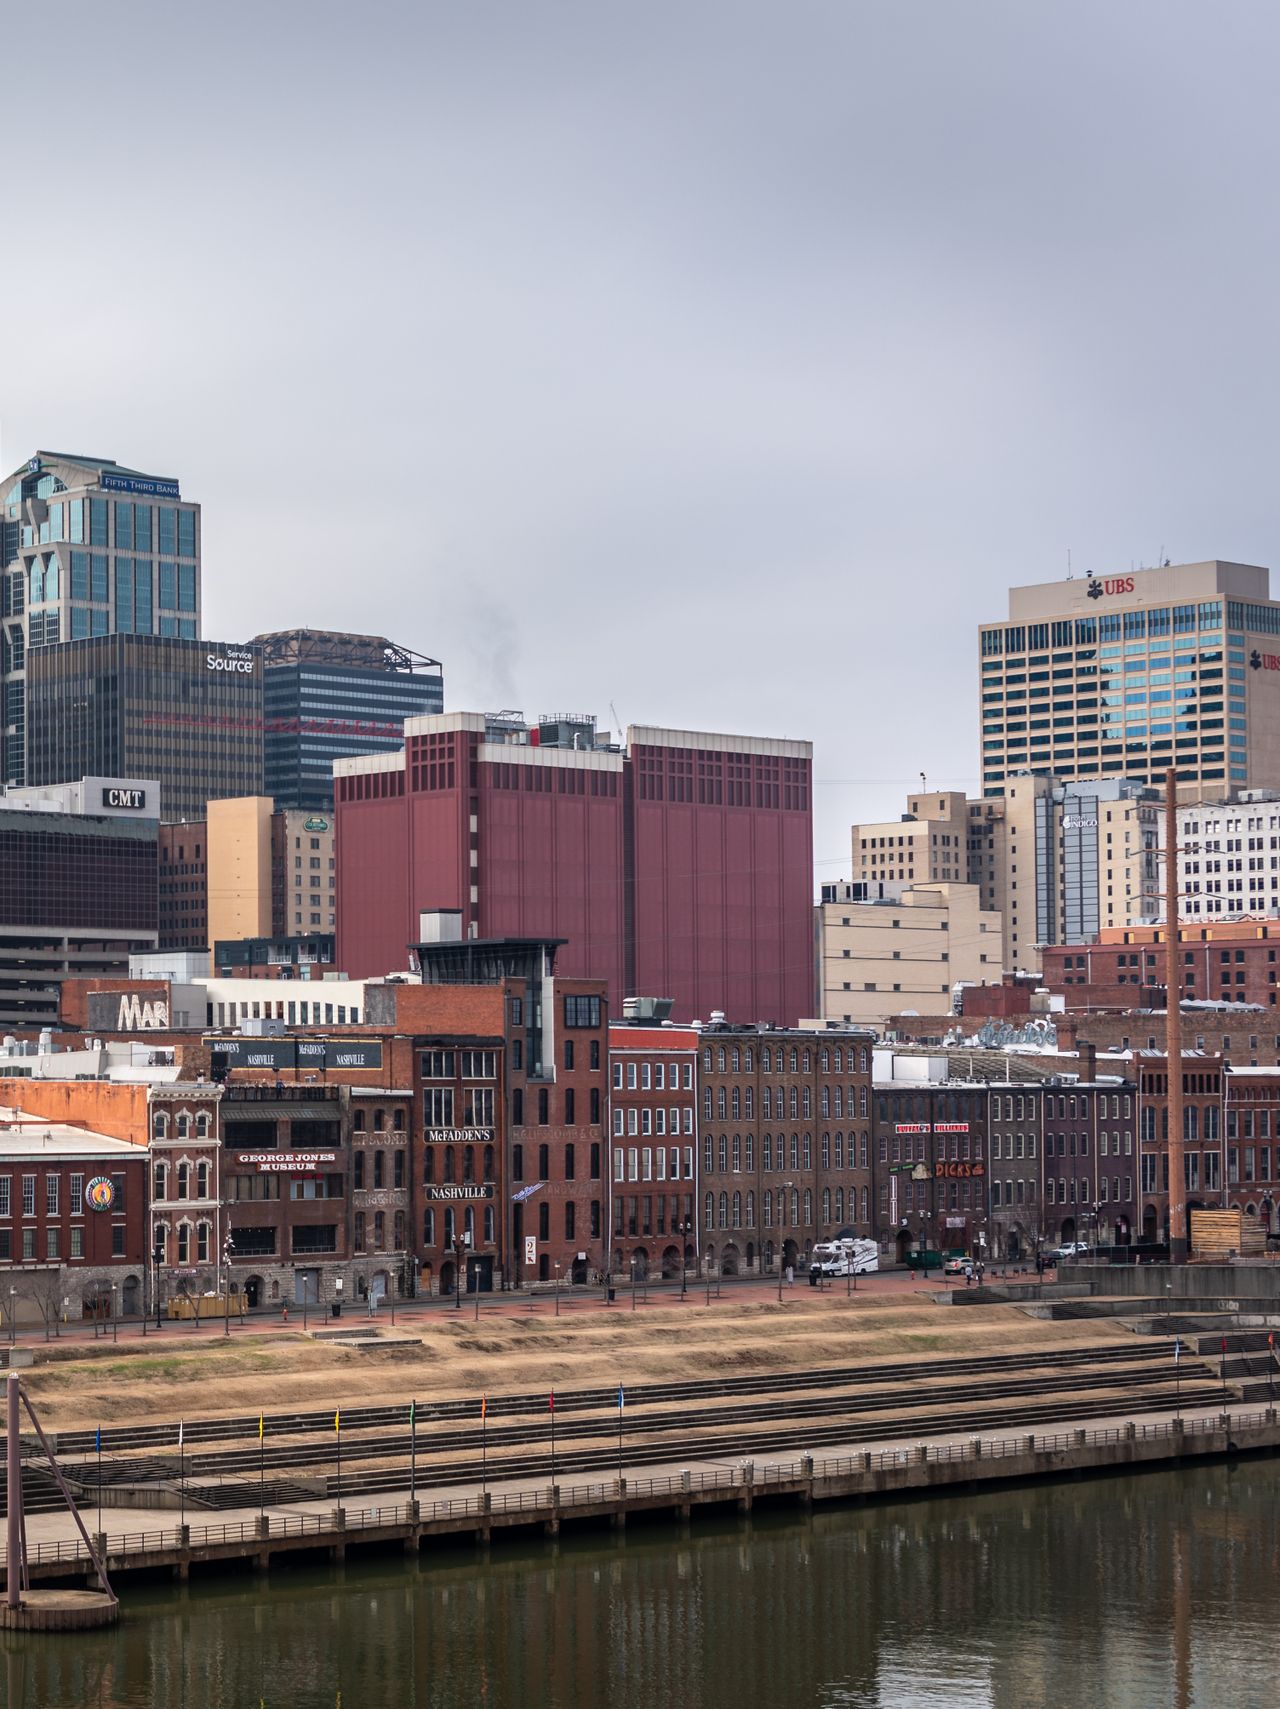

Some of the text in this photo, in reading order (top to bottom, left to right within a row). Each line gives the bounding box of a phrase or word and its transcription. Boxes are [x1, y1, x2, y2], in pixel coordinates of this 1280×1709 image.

[105, 477, 178, 494] FIFTH THIRD BANK
[1104, 577, 1135, 596] UBS
[227, 650, 252, 660] Service
[207, 655, 253, 673] Source
[109, 789, 142, 808] CMT
[247, 1054, 275, 1066] NASHVILLE
[336, 1054, 365, 1065] NASHVILLE
[429, 1129, 491, 1142] McFADDEN'S
[239, 1153, 336, 1163] GEORGE JONES
[259, 1163, 317, 1171] MUSEUM
[431, 1186, 488, 1199] NASHVILLE
[527, 1242, 533, 1253] 2
